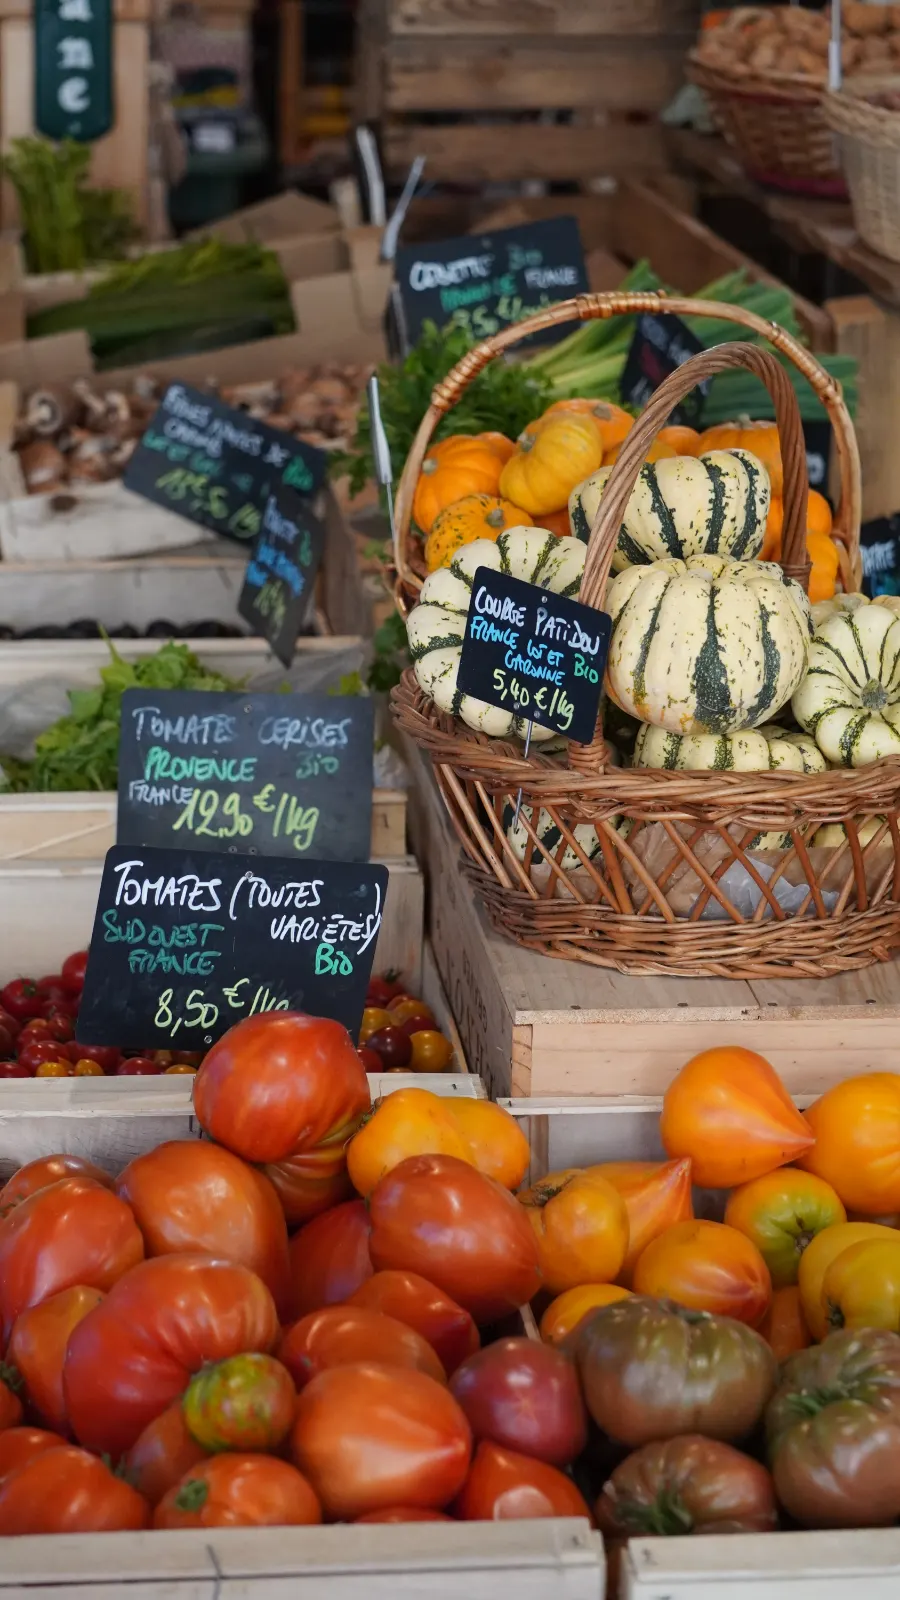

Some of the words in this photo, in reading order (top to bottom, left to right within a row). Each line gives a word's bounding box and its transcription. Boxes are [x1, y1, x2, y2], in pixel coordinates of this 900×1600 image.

[475, 586, 527, 627] COURGE
[470, 616, 519, 649] FRANCE
[527, 639, 548, 660] LOT
[547, 653, 564, 667] ET
[493, 668, 530, 707] 5,40
[132, 706, 237, 746] TOMATES
[258, 716, 352, 750] CERISES
[144, 746, 258, 782] PROVENCE
[129, 779, 194, 806] FRANCE
[172, 788, 254, 838] 12,90
[114, 860, 222, 911] TOMATES
[229, 875, 325, 921] (TOUTES
[102, 908, 147, 944] SUD
[148, 922, 225, 948] OUEST
[128, 948, 222, 976] FRANCE
[154, 987, 219, 1038] 8,50
